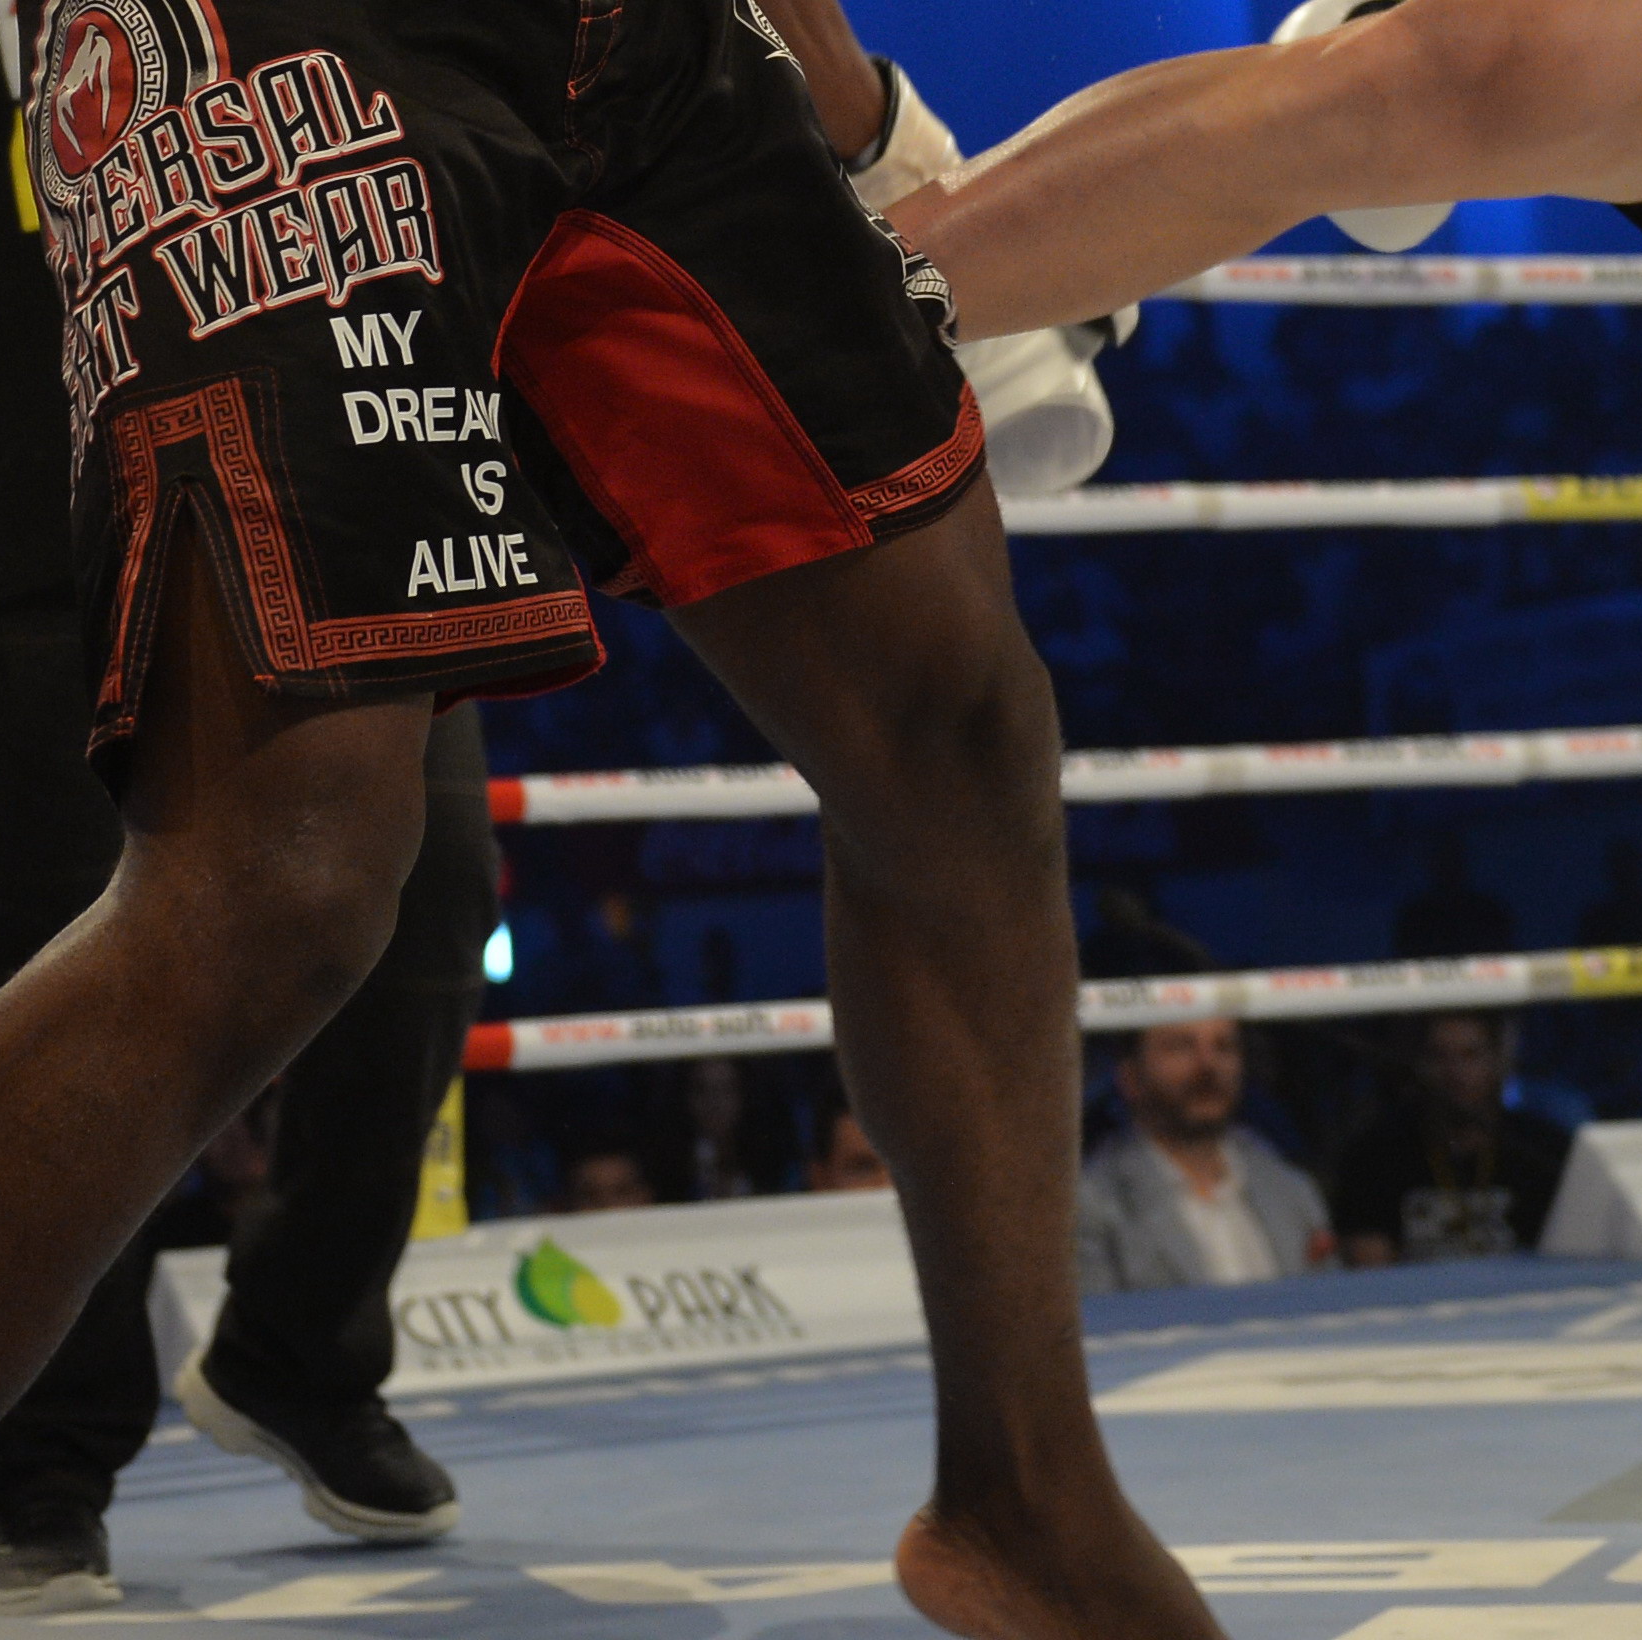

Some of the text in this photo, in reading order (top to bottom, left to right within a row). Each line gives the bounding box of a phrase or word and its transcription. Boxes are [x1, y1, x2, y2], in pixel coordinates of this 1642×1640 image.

[154, 158, 445, 341] WEAR
[329, 310, 422, 368] MY
[461, 460, 507, 515] IS
[408, 533, 539, 597] ALIVE
[397, 1289, 515, 1348] CITY
